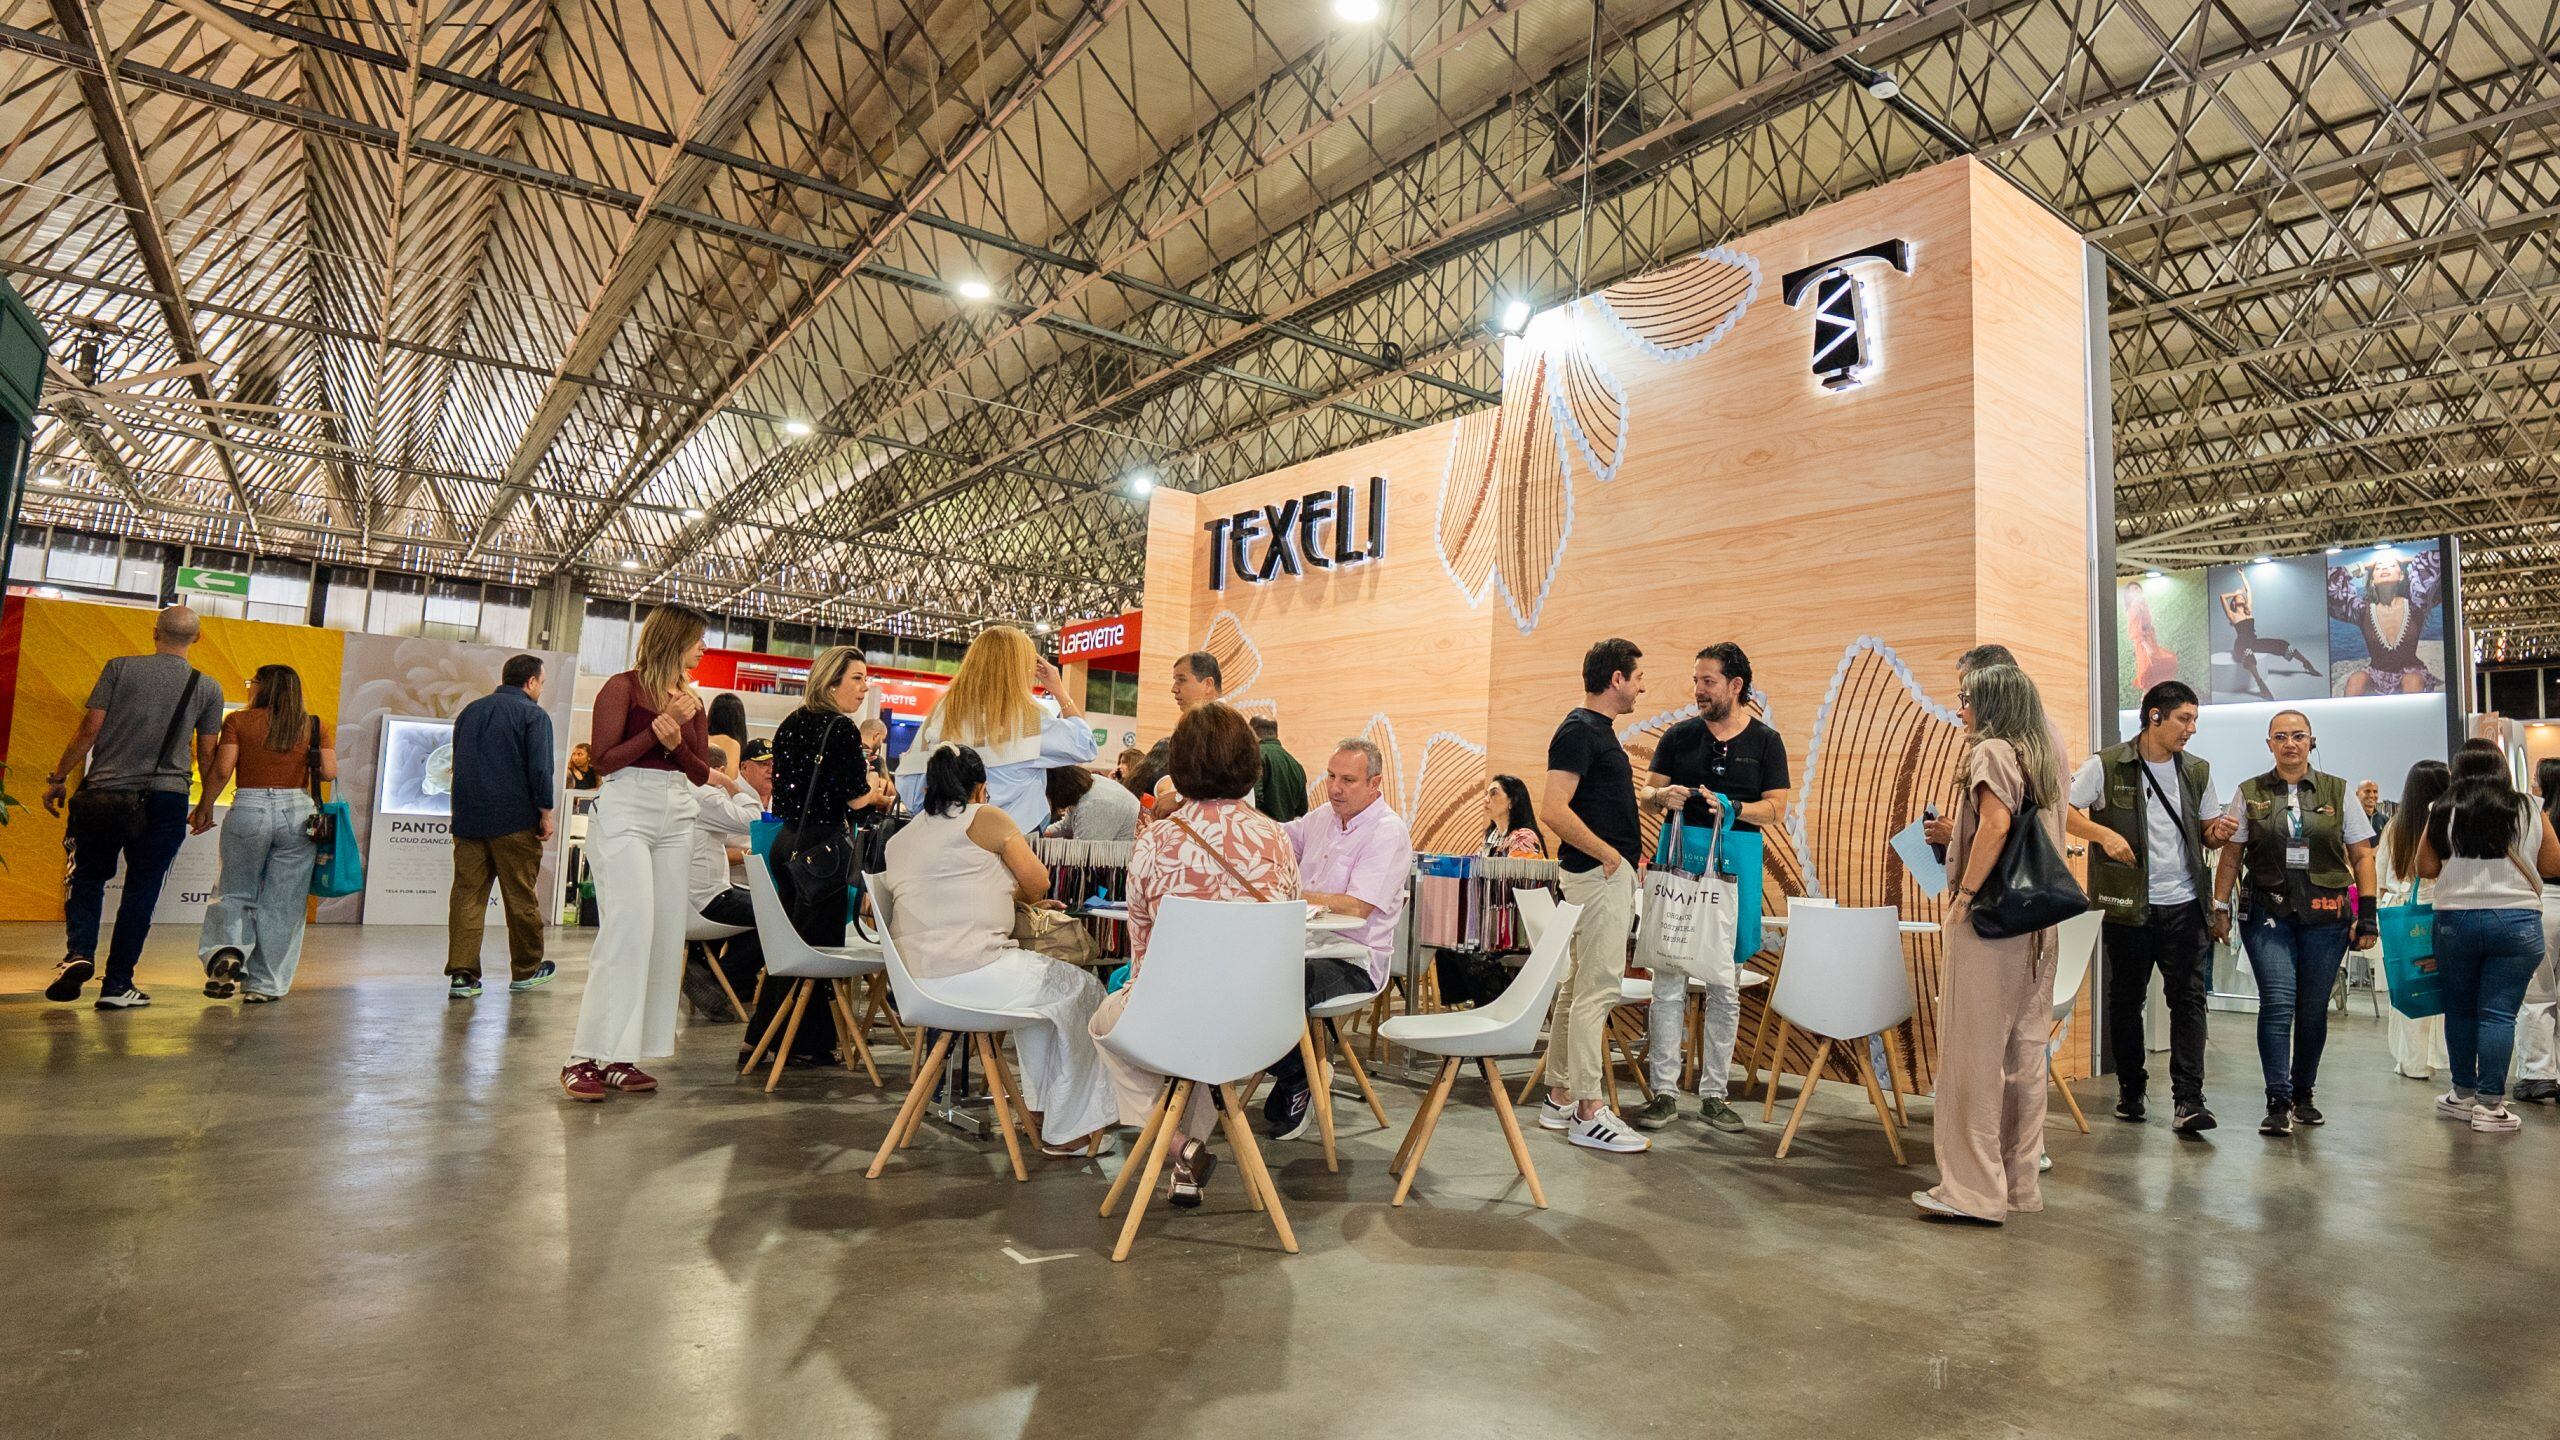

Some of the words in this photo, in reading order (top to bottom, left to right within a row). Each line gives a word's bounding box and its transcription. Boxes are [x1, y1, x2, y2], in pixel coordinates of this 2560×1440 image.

[1204, 476, 1386, 592] TEXELI
[392, 821, 452, 834] PANTO
[389, 836, 419, 844] CLOUD
[180, 892, 212, 903] SUT
